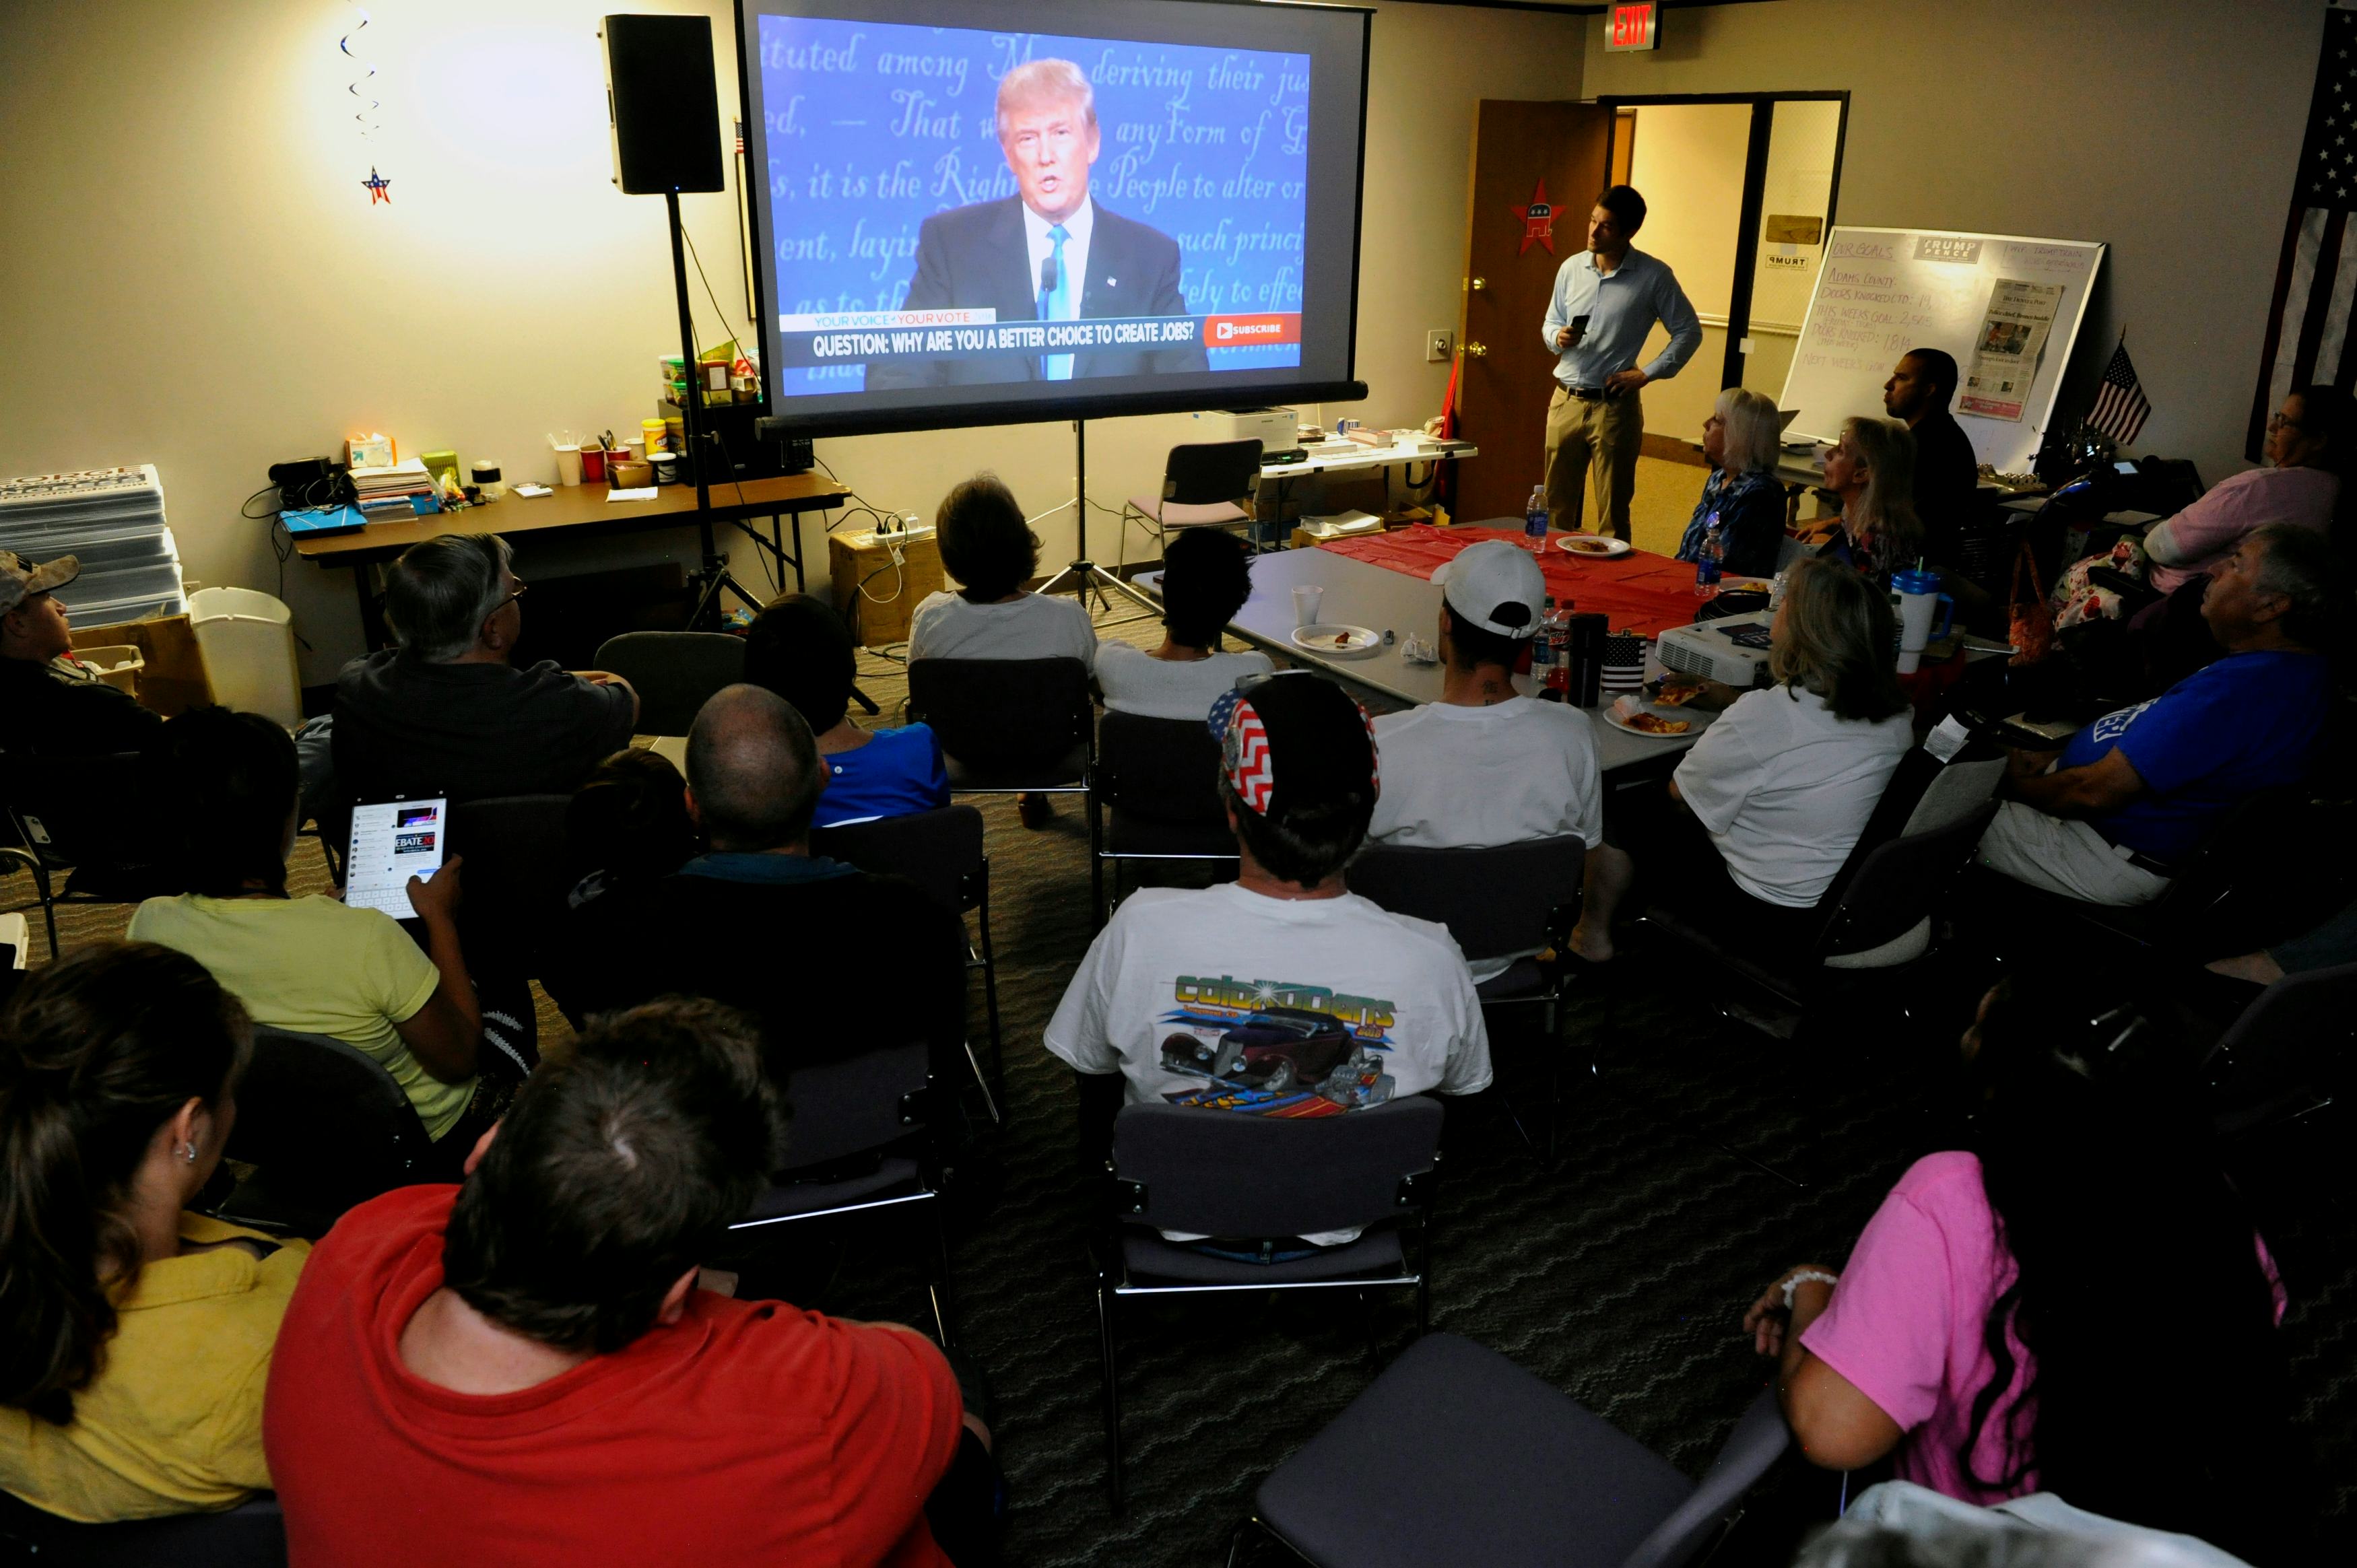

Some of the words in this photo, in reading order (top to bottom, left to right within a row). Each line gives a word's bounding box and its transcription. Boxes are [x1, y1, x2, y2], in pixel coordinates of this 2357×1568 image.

[1613, 5, 1651, 46] EXIT
[877, 52, 969, 97] among
[1092, 48, 1193, 104] deriving
[1207, 55, 1265, 90] their
[890, 88, 961, 139] That
[1116, 121, 1162, 164] any
[1166, 97, 1226, 144] Form
[1240, 110, 1271, 162] of
[809, 163, 833, 199] it
[842, 163, 869, 199] is
[877, 160, 926, 199] the
[1108, 145, 1187, 213] People
[1193, 174, 1216, 199] to
[1222, 162, 1275, 199] alter
[1282, 180, 1304, 199] or
[1178, 217, 1233, 251] such
[1856, 242, 1894, 259] GOALS
[1924, 240, 1977, 251] TRUMP
[1925, 248, 1969, 257] PENCE
[1231, 278, 1253, 304] to
[1828, 268, 1860, 283] ADAMS
[815, 317, 849, 327] YOUR
[852, 315, 889, 327] VOICE
[898, 314, 934, 325] YOUR
[936, 312, 970, 323] VOTE
[1232, 323, 1282, 335] SUBSCRIBE
[813, 333, 890, 357] QUESTION:
[891, 331, 925, 353] WHY
[926, 330, 953, 351] ARE
[954, 329, 985, 350] YOU
[986, 329, 997, 349] A
[999, 327, 1045, 348] BETTER
[1047, 325, 1093, 346] CHOICE
[1095, 325, 1112, 343] TO
[1114, 322, 1159, 343] CREATE
[1160, 320, 1195, 341] JOBS?
